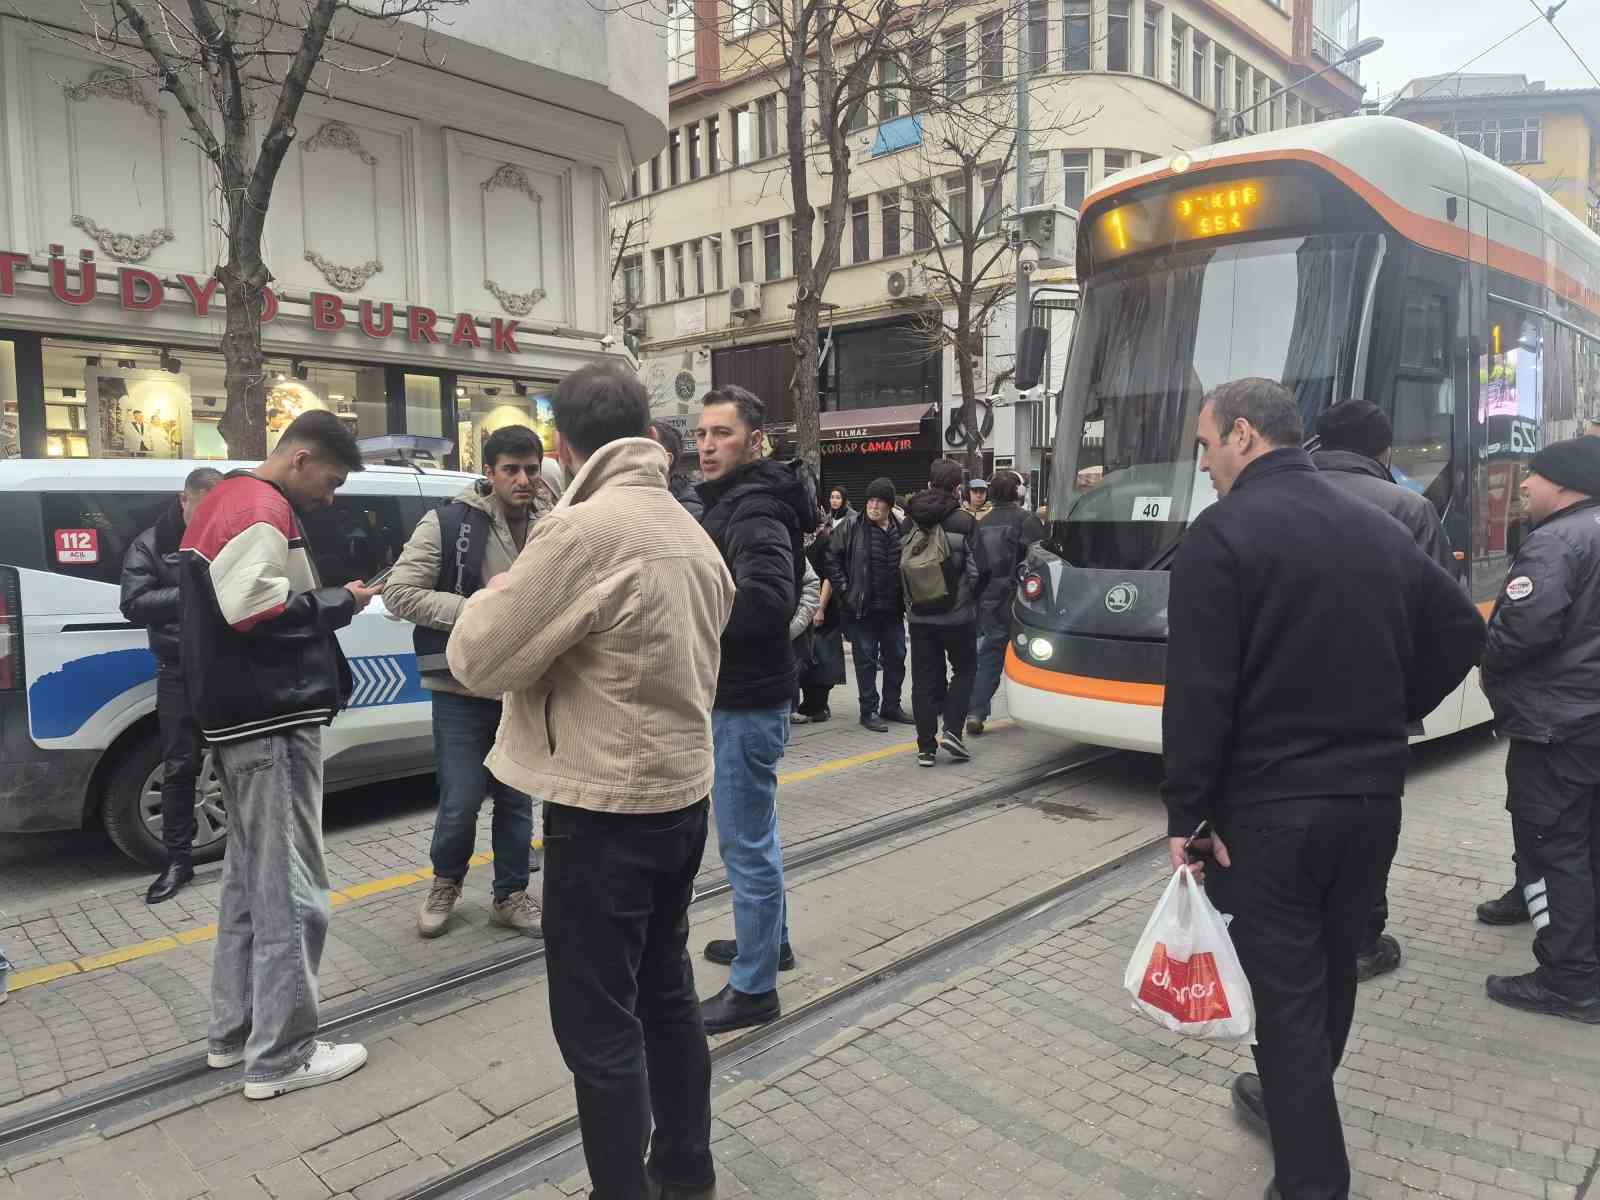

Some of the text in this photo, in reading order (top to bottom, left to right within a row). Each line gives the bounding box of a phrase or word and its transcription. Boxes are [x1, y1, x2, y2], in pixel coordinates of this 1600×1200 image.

[1112, 210, 1127, 249] 1
[310, 291, 522, 353] BURAK
[835, 428, 867, 437] YILMAZ
[1142, 503, 1160, 518] 40
[60, 532, 92, 549] 112
